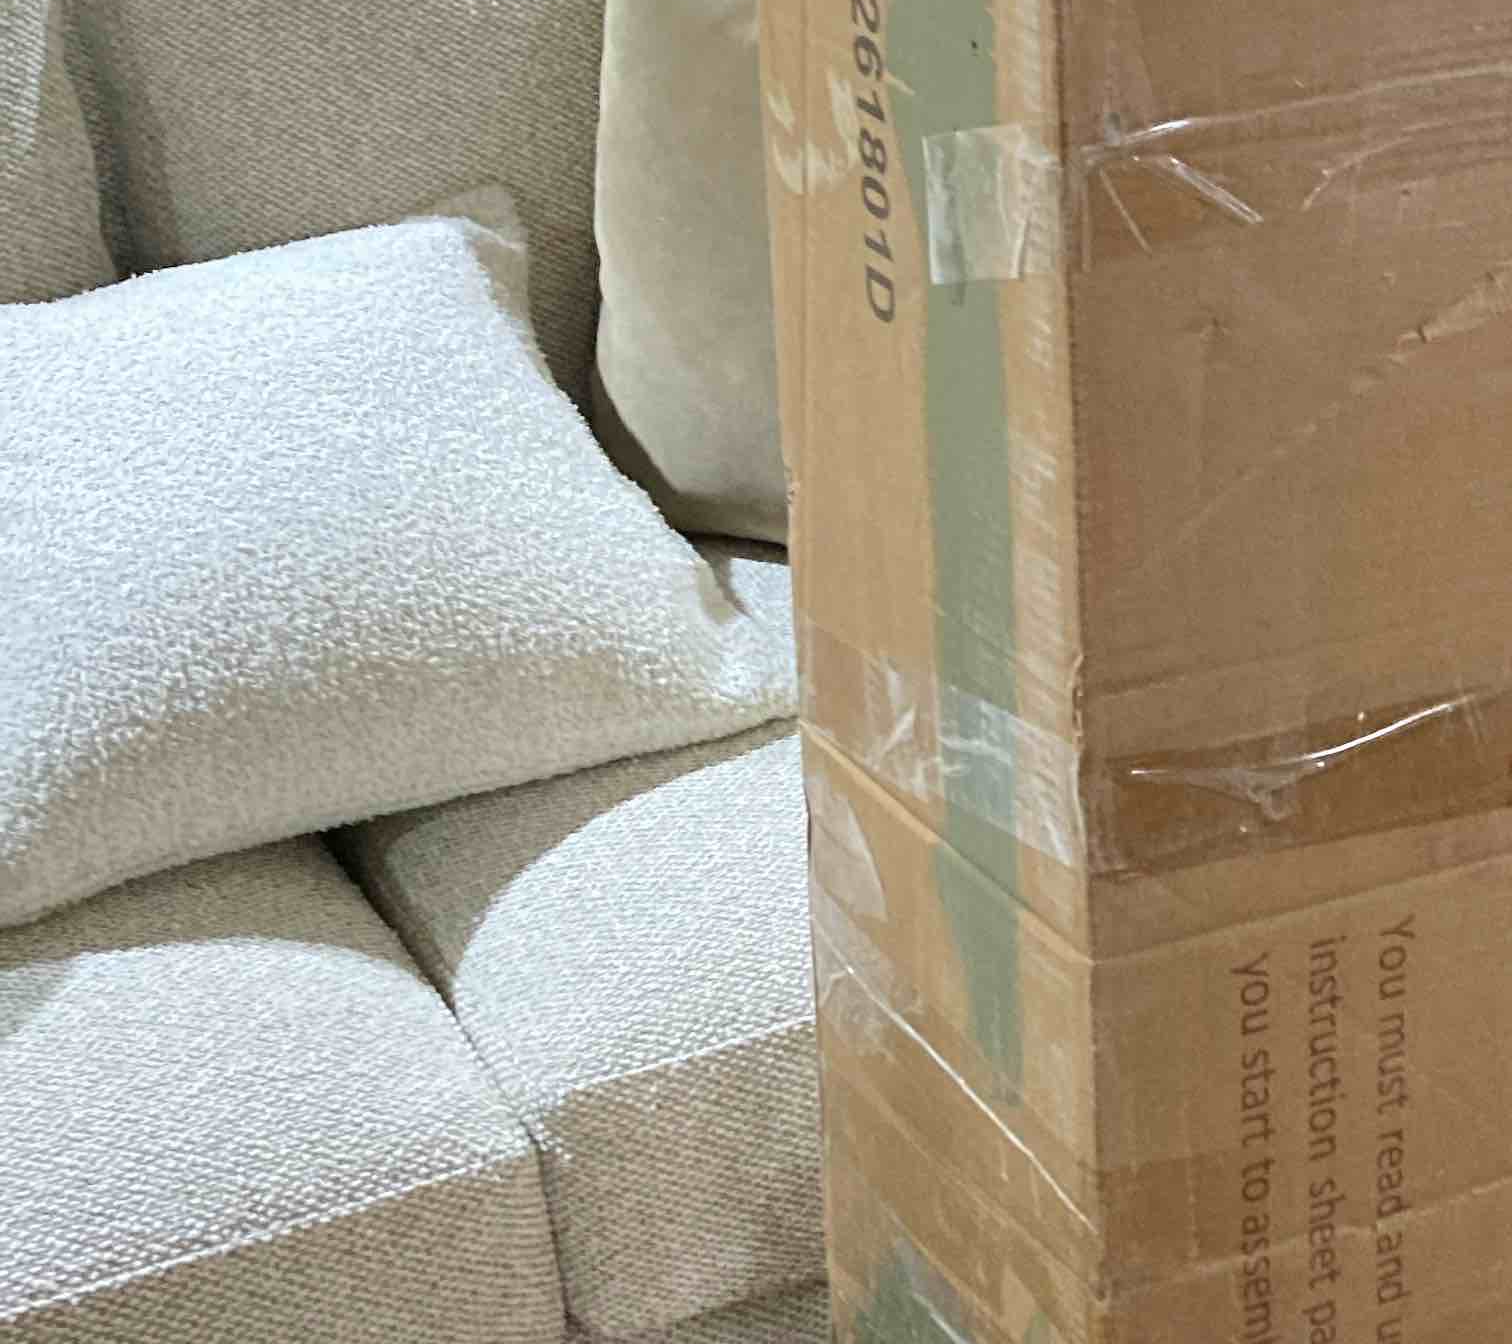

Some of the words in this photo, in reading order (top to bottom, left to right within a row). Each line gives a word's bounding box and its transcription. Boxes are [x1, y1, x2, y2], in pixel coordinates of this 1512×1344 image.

[1230, 952, 1270, 1037] you
[1377, 913, 1416, 1002] You
[1307, 935, 1347, 1161] instruction
[1376, 1010, 1408, 1116] must
[1240, 1049, 1277, 1150] start
[1240, 1157, 1275, 1203] to
[1375, 1129, 1411, 1219] read
[1308, 1178, 1347, 1290] sheet
[1375, 1234, 1411, 1306] and
